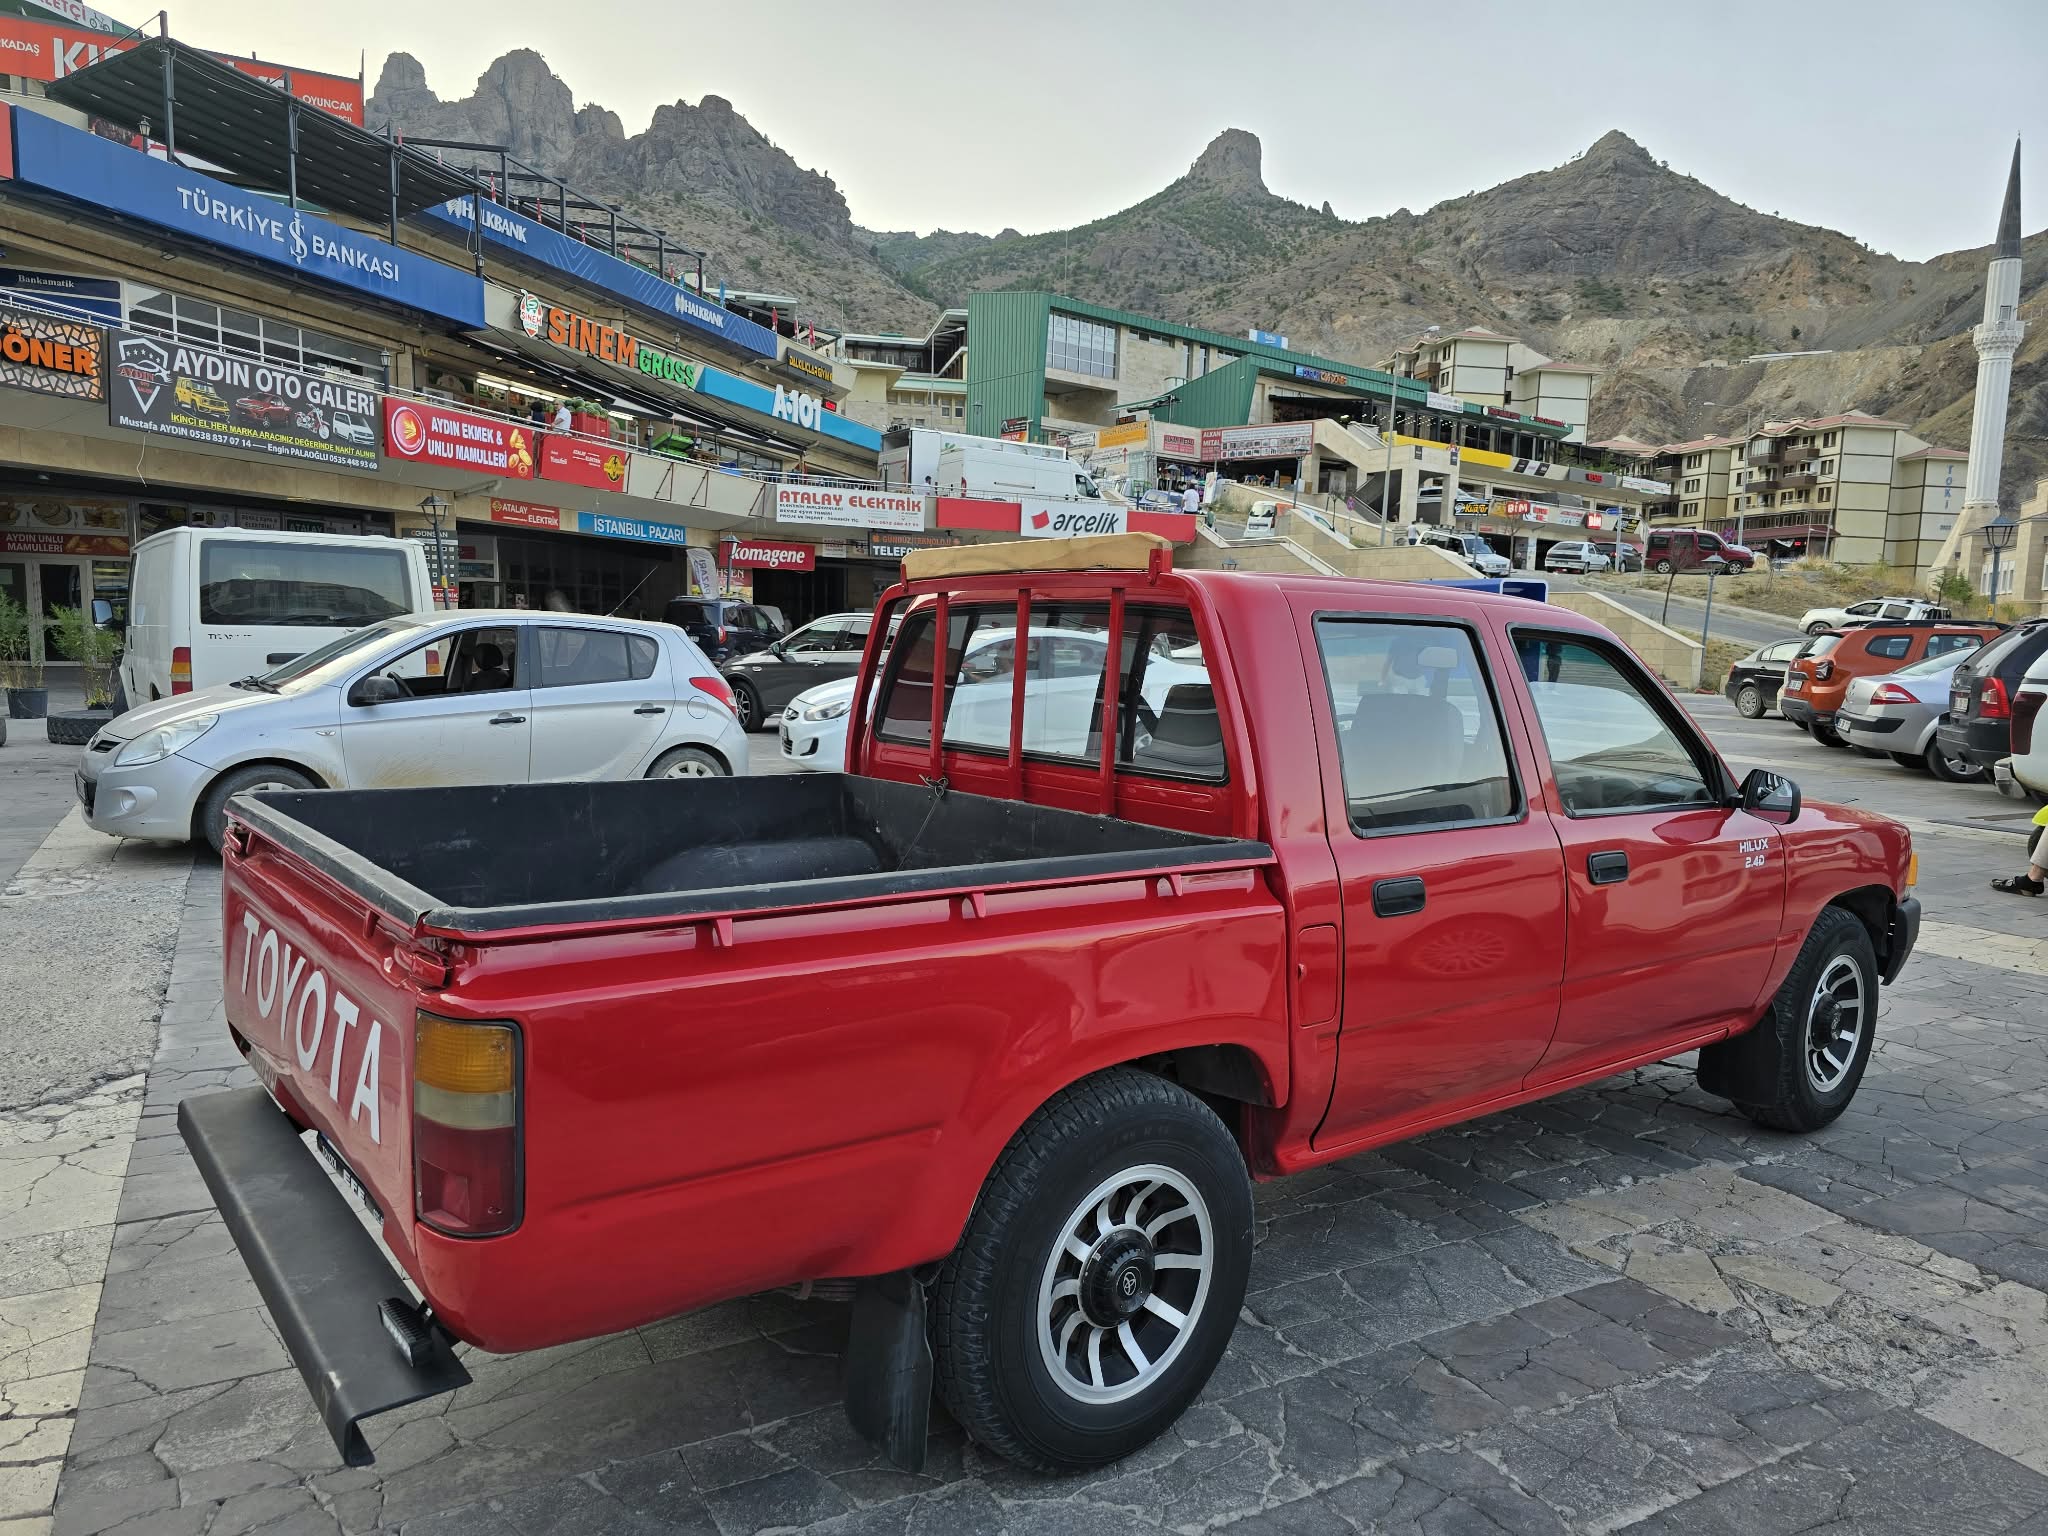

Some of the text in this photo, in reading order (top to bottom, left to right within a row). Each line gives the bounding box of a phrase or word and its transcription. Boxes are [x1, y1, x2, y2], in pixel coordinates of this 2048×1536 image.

[302, 94, 353, 112] OYUNCAK
[176, 187, 285, 243] TÜRKİYE
[312, 235, 399, 282] BANKASI
[18, 274, 75, 289] Bankamatik
[684, 299, 725, 329] HALKBANK
[0, 326, 95, 376] ÖNER
[548, 307, 697, 388] SİNEM GROSS
[172, 348, 375, 417] AYDIN OTO GALERİ
[120, 415, 158, 431] Mustafa
[160, 424, 188, 437] AYDIN
[189, 429, 211, 440] 0538
[212, 433, 228, 443] 837
[229, 436, 239, 445] 07
[241, 438, 252, 447] 14
[267, 443, 290, 455] Engin
[290, 447, 329, 461] PALAOĞLU
[329, 454, 346, 464] 0535
[198, 418, 210, 429] EL
[211, 420, 228, 432] HER
[229, 425, 259, 438] MARKA
[259, 430, 294, 444] ARACINIZ
[295, 436, 334, 450] DEĞERİNDE
[431, 416, 504, 445] AYDIN EKMEK &
[427, 438, 508, 469] UNLU MAMULLERİ
[502, 503, 528, 515] ATALAY
[779, 490, 922, 513] ATALAY ELEKTRİK
[527, 514, 559, 527] ELEKTRİK
[593, 514, 684, 542] İSTANBUL PAZARI
[1053, 512, 1120, 537] arçelik
[6, 533, 64, 544] AYDIN UNLU
[7, 542, 63, 553] MAMULLERİ
[731, 541, 806, 568] komagene
[1739, 837, 1769, 854] HILUX
[241, 910, 382, 1145] TOYOTA
